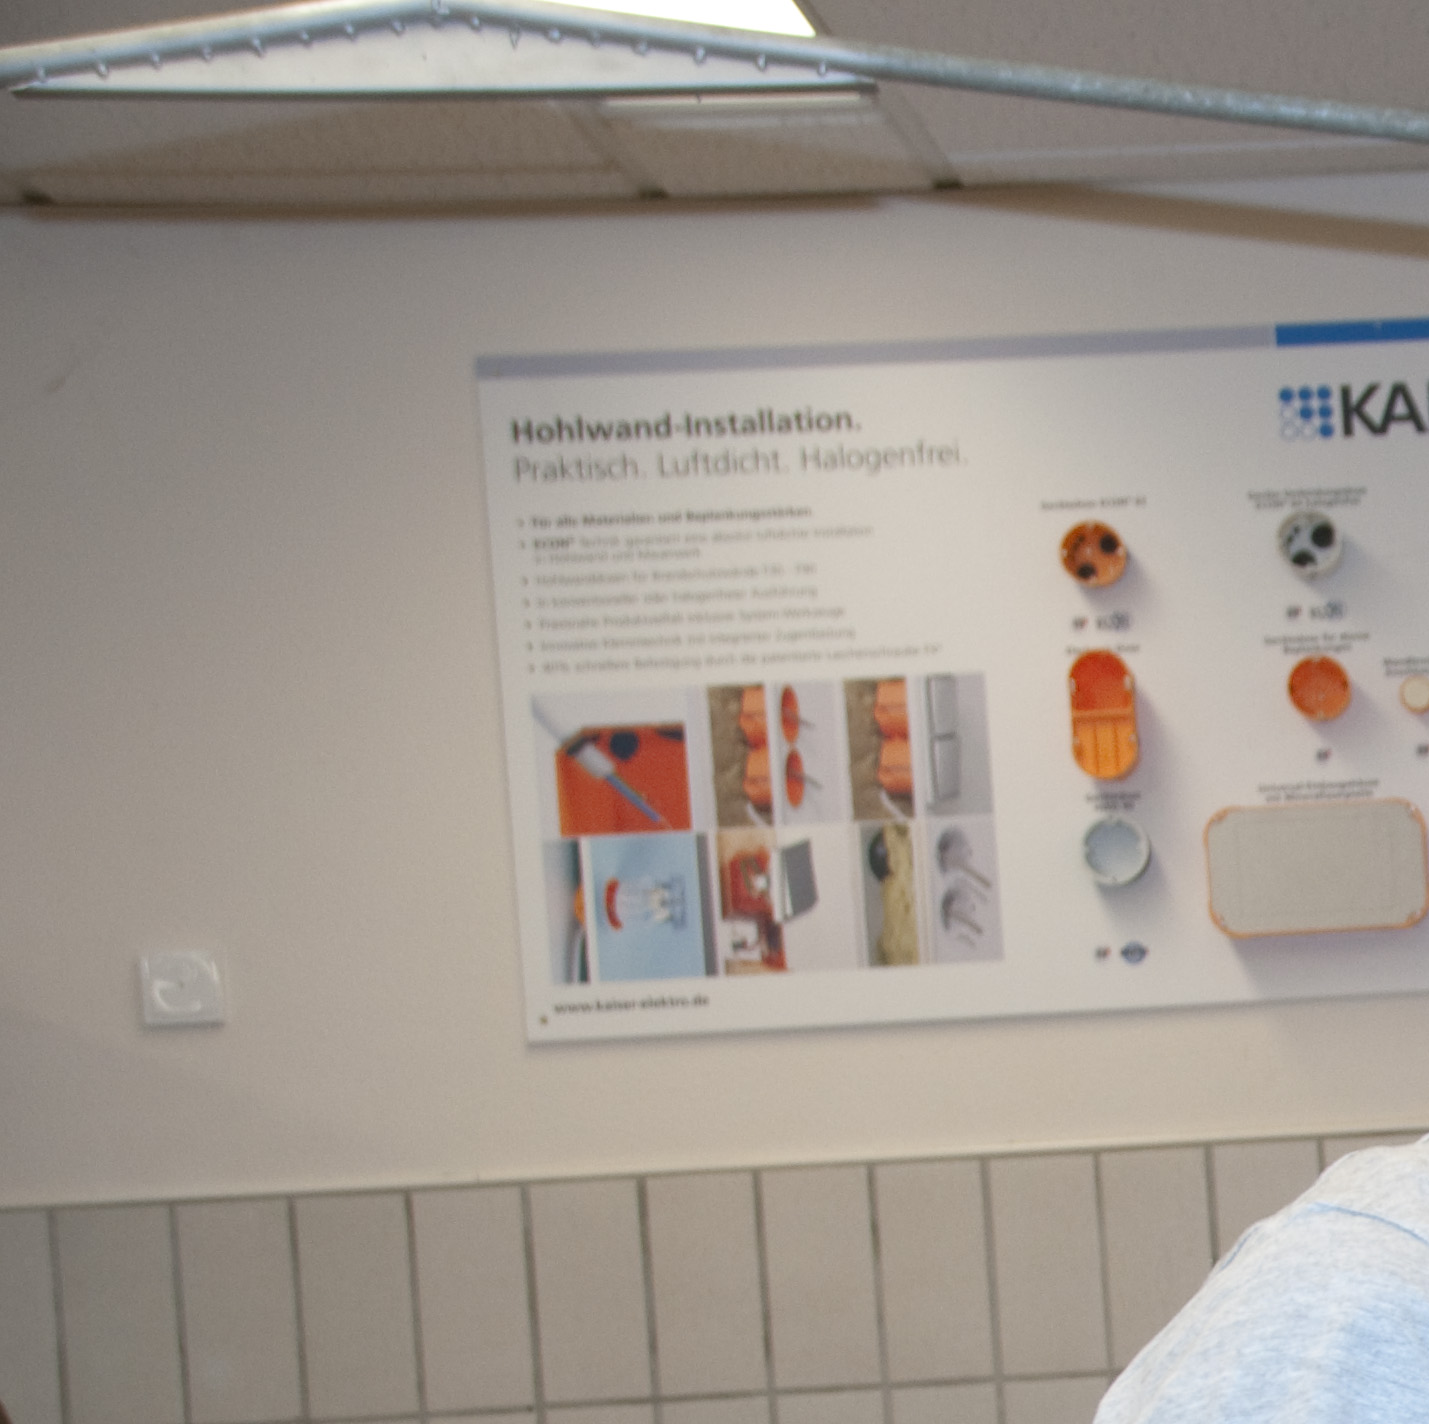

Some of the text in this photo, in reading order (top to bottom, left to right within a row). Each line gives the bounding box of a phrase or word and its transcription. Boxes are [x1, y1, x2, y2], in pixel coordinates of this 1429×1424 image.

[511, 408, 861, 444] Hohlwand-Installation.
[514, 440, 969, 484] Praktisch. Luftdicht. Halogenfrei.
